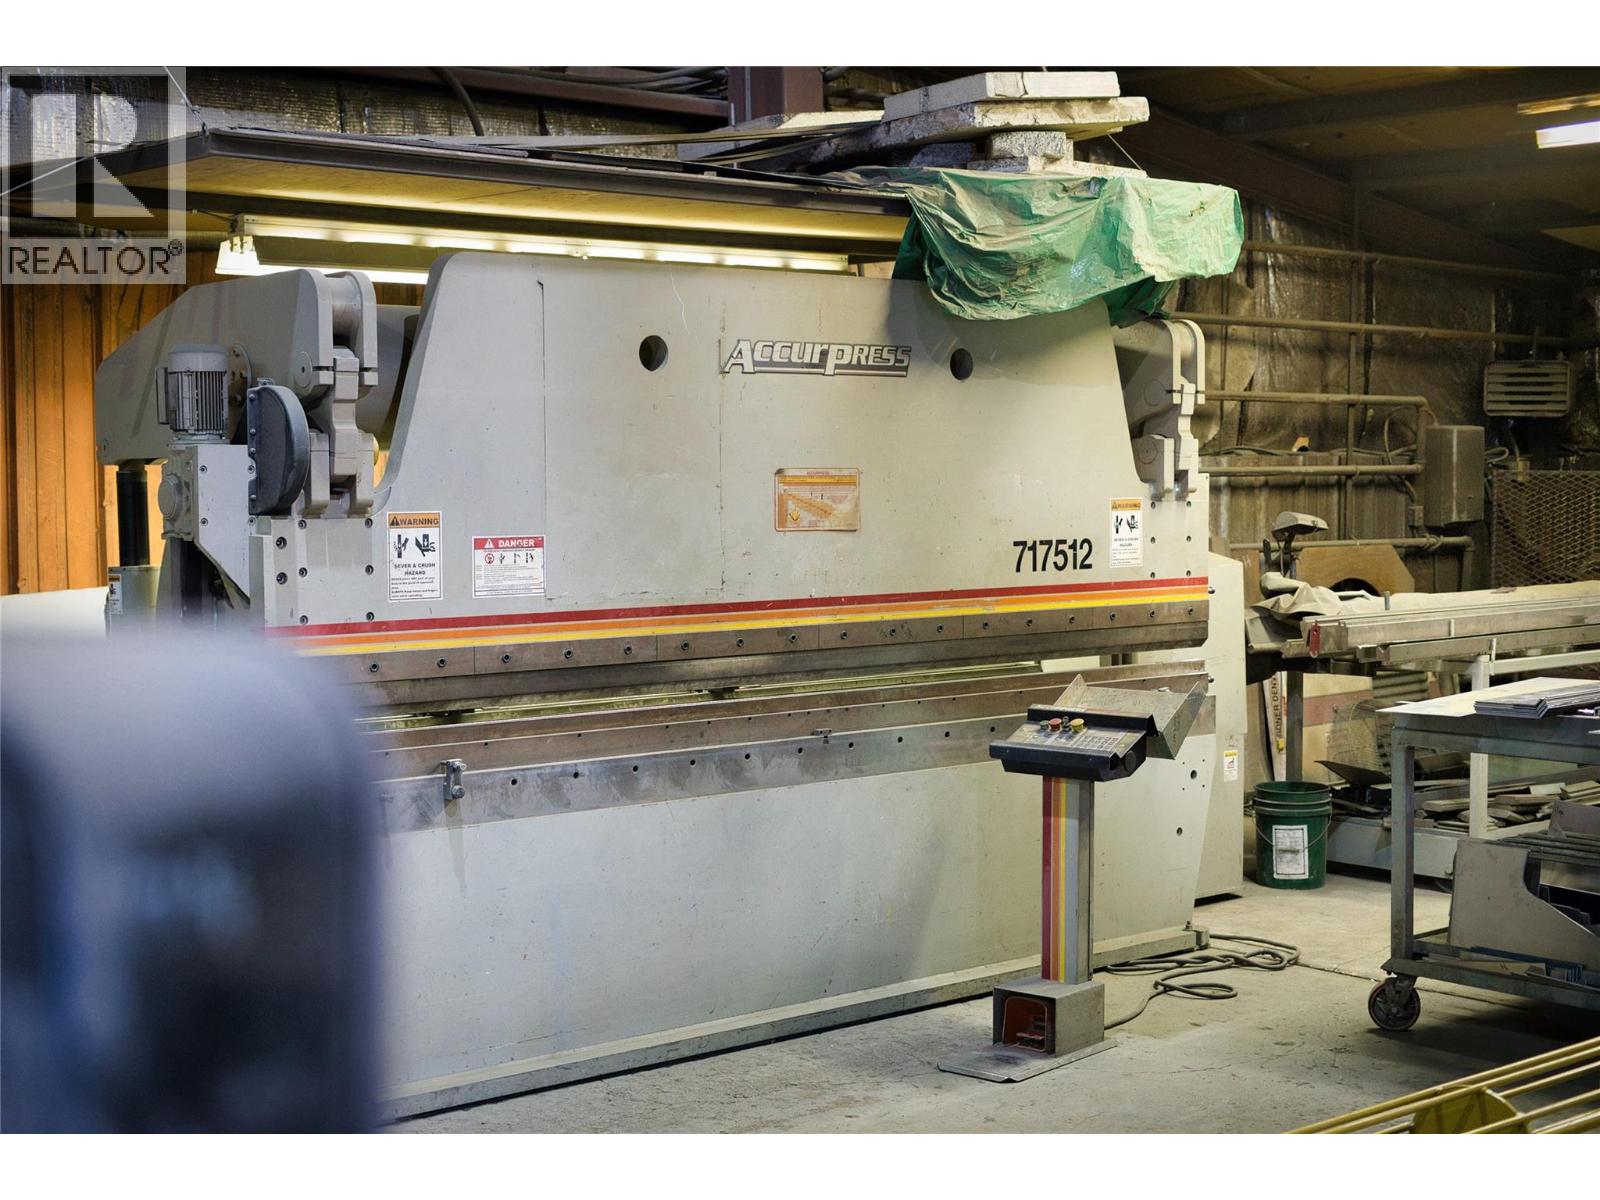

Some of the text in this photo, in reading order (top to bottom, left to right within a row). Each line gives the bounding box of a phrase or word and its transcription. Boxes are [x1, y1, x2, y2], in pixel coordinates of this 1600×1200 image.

[400, 517, 439, 526] WARNING
[498, 539, 535, 548] DANGER
[1013, 538, 1093, 573] 717512
